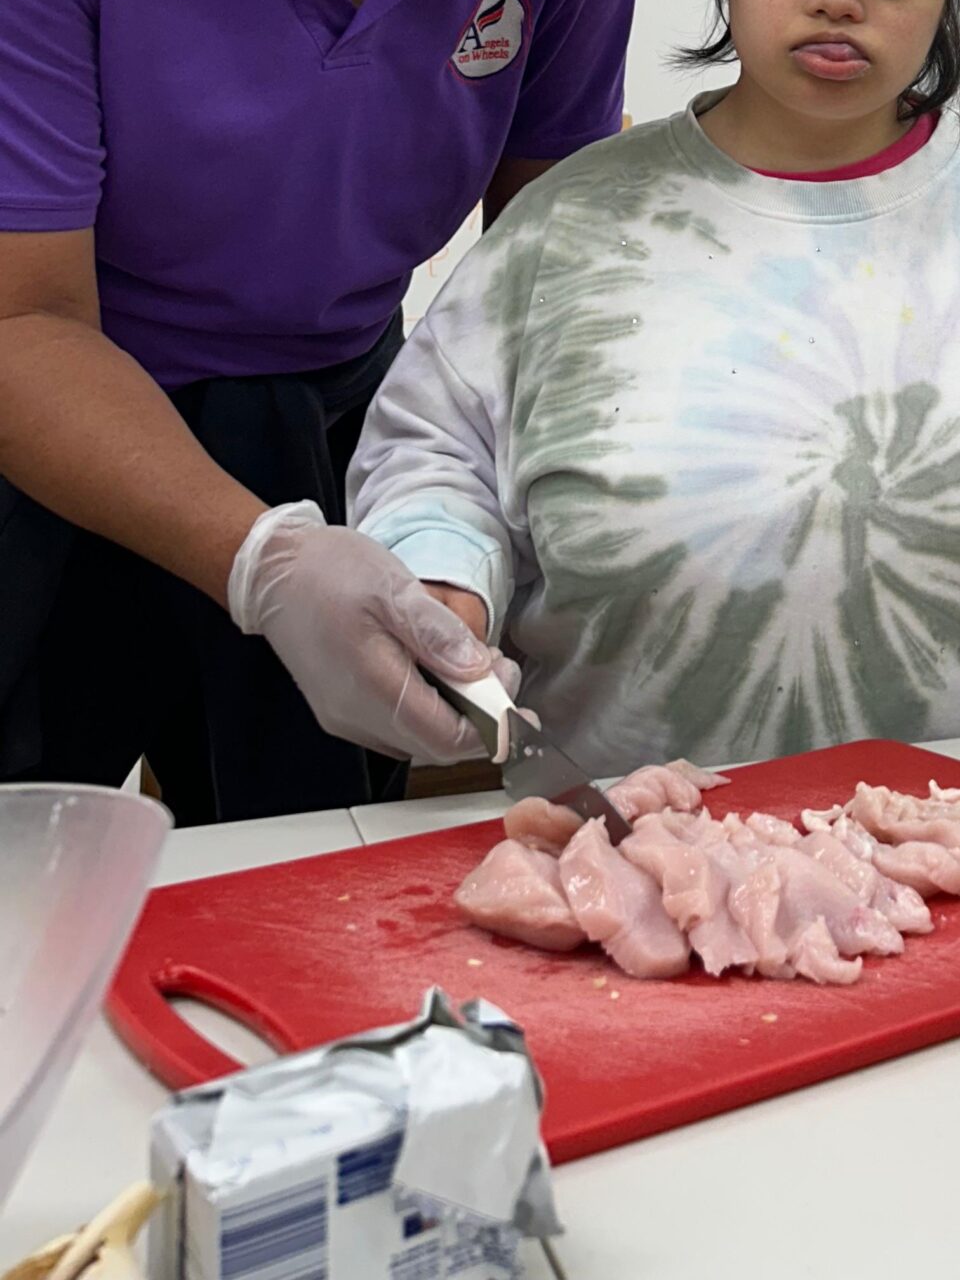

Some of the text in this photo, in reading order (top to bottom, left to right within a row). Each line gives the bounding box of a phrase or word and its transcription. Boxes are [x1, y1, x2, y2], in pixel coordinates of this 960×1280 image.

[458, 21, 509, 53] Angels
[458, 49, 509, 63] on Wheels
